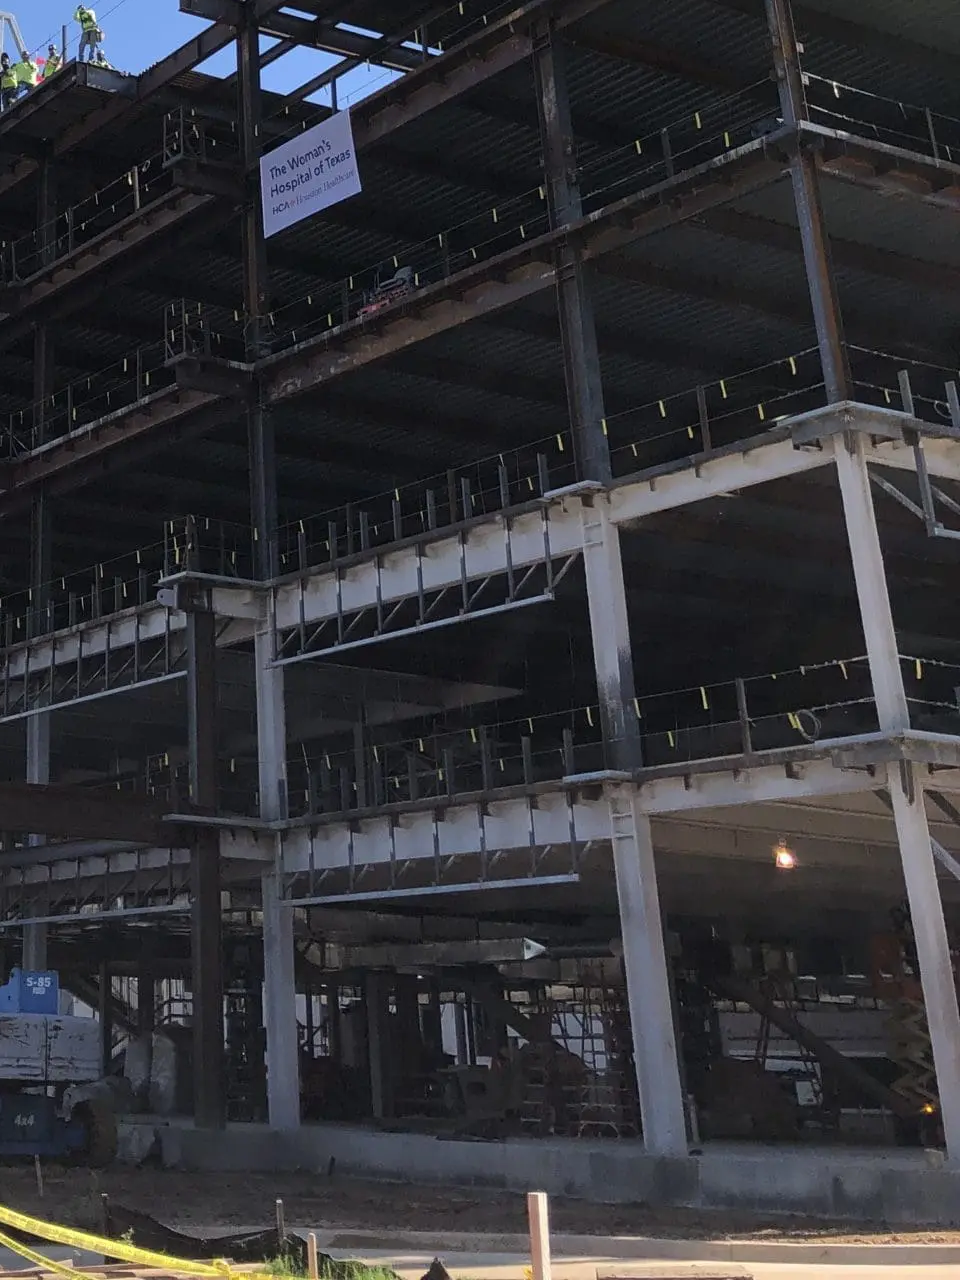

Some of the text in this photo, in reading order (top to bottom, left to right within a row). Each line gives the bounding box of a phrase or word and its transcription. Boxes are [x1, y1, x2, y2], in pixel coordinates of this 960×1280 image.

[269, 139, 332, 180] The Woman's
[270, 149, 351, 198] Hospital of Texas
[272, 202, 290, 215] HCA
[26, 976, 52, 988] S-85
